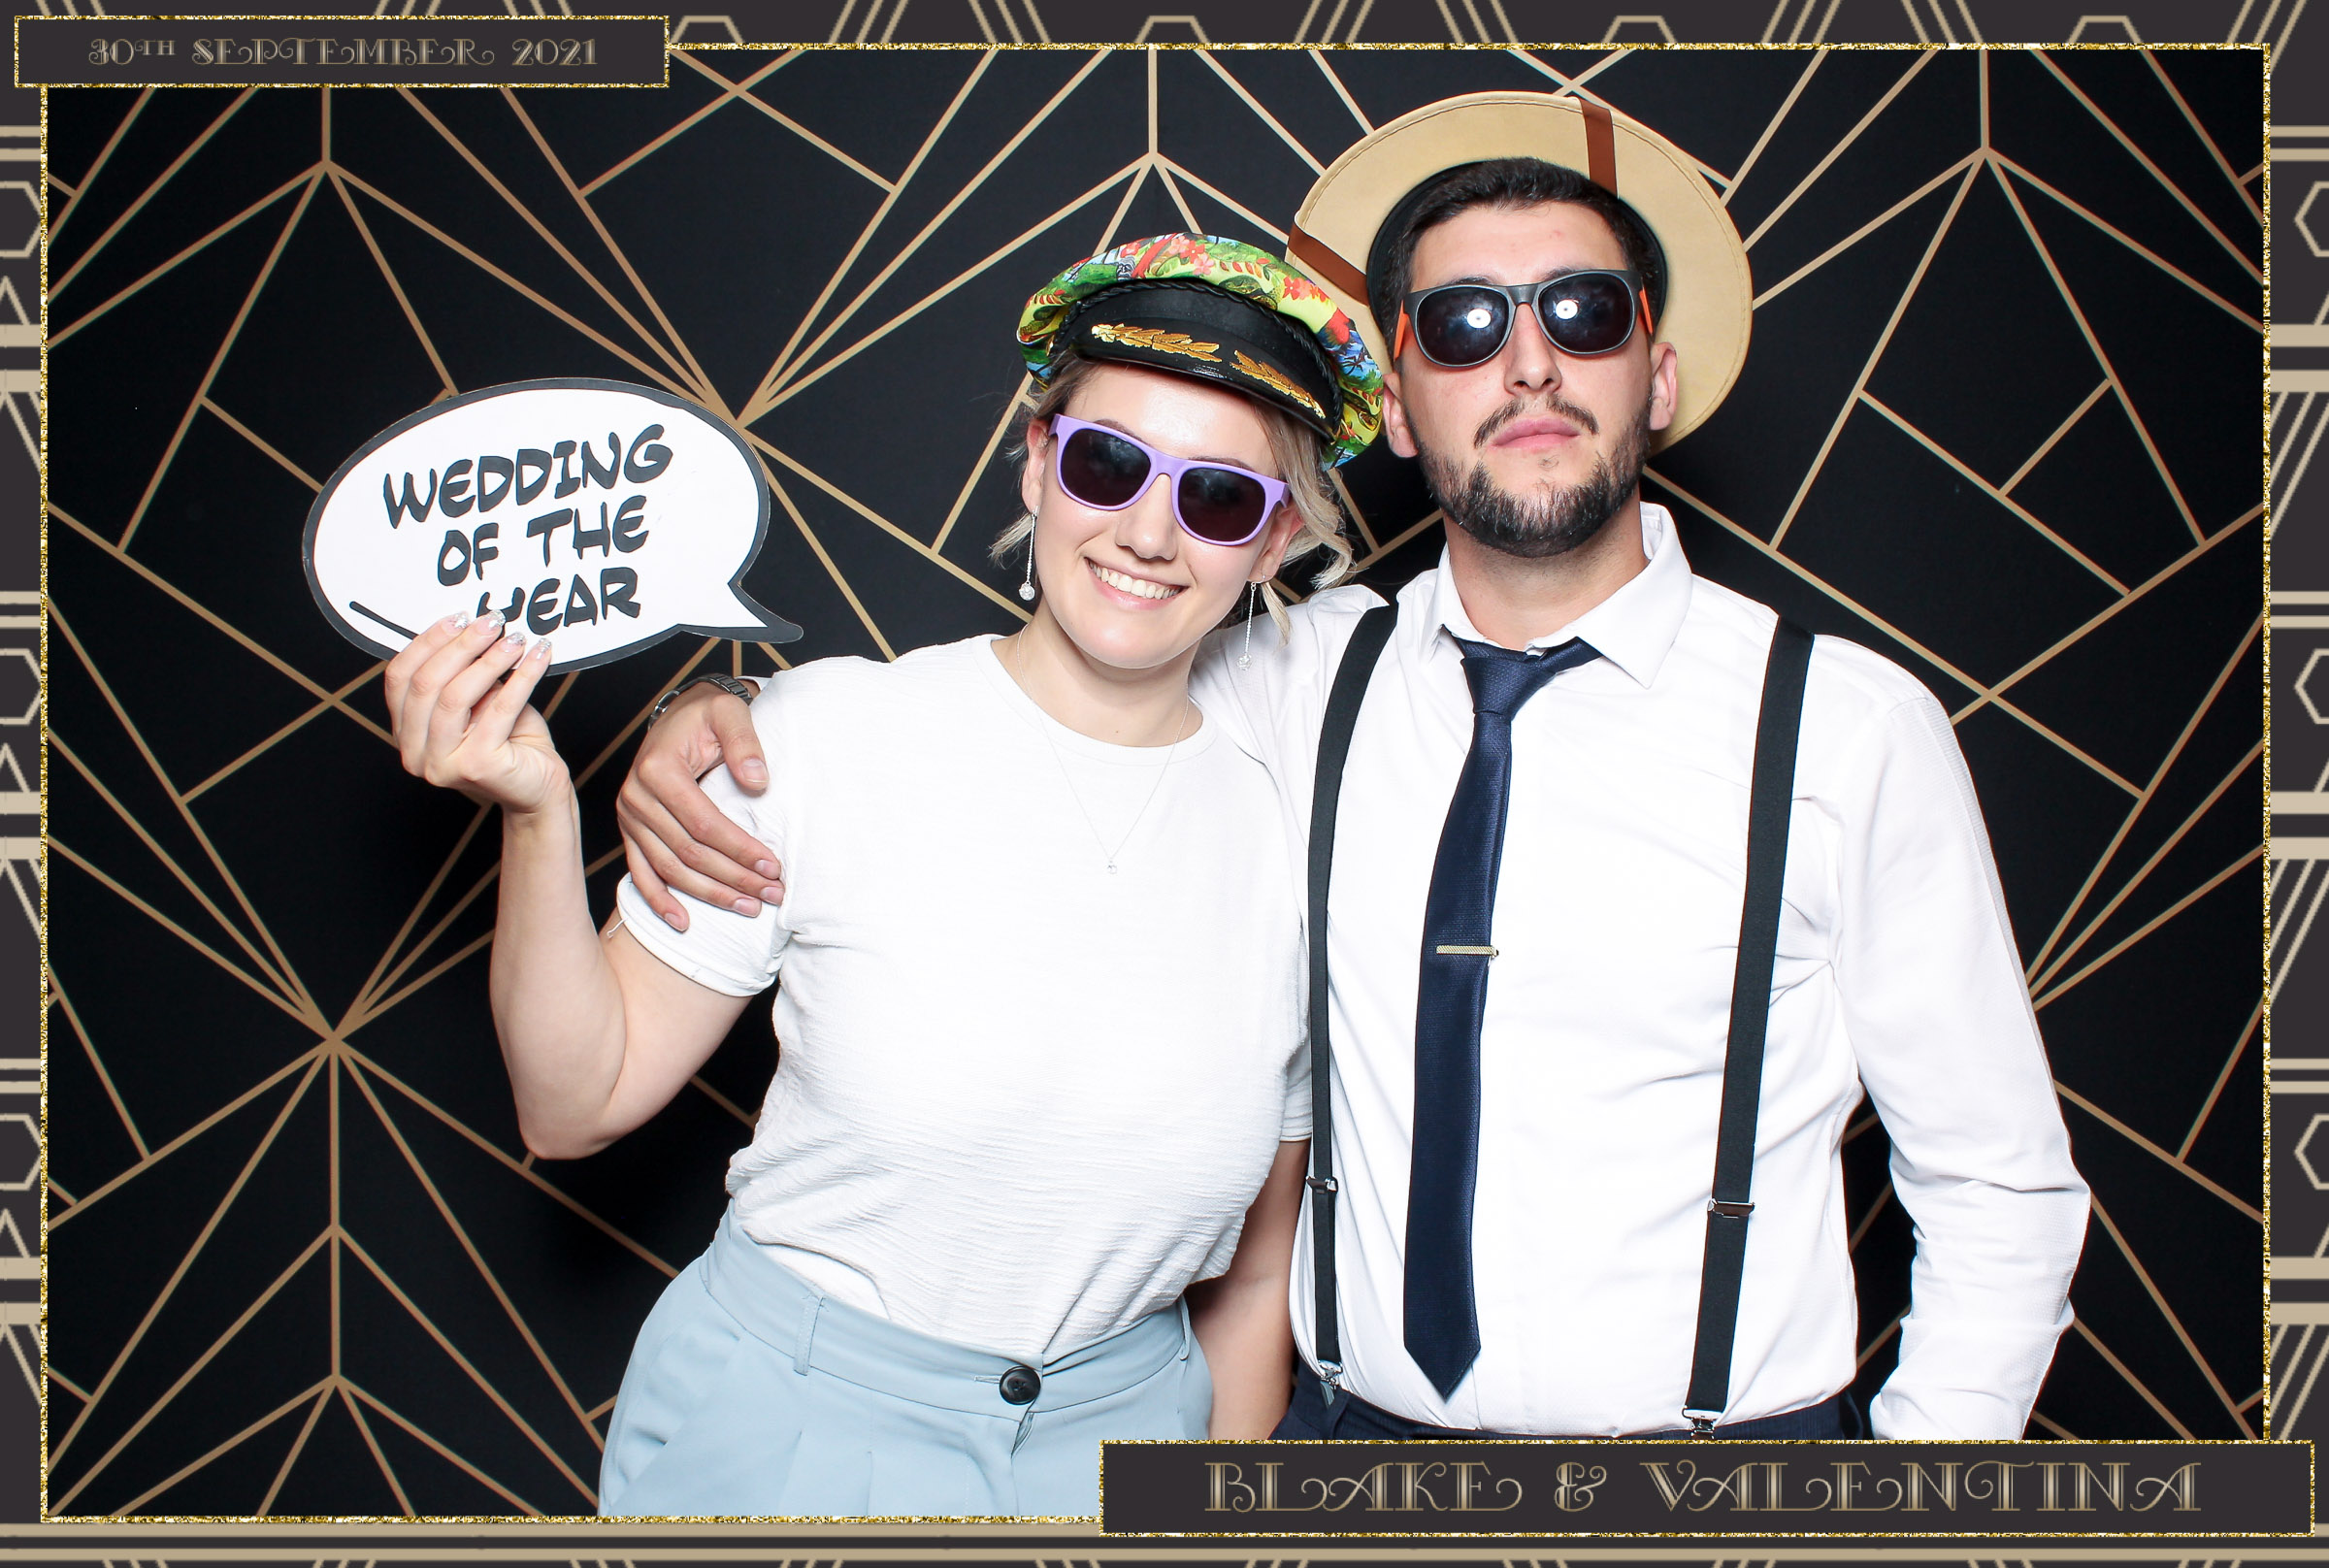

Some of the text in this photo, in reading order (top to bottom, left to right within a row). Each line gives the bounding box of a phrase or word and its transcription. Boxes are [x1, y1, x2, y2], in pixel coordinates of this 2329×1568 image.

[383, 423, 673, 530] WEDDING
[437, 494, 650, 587] OF THE
